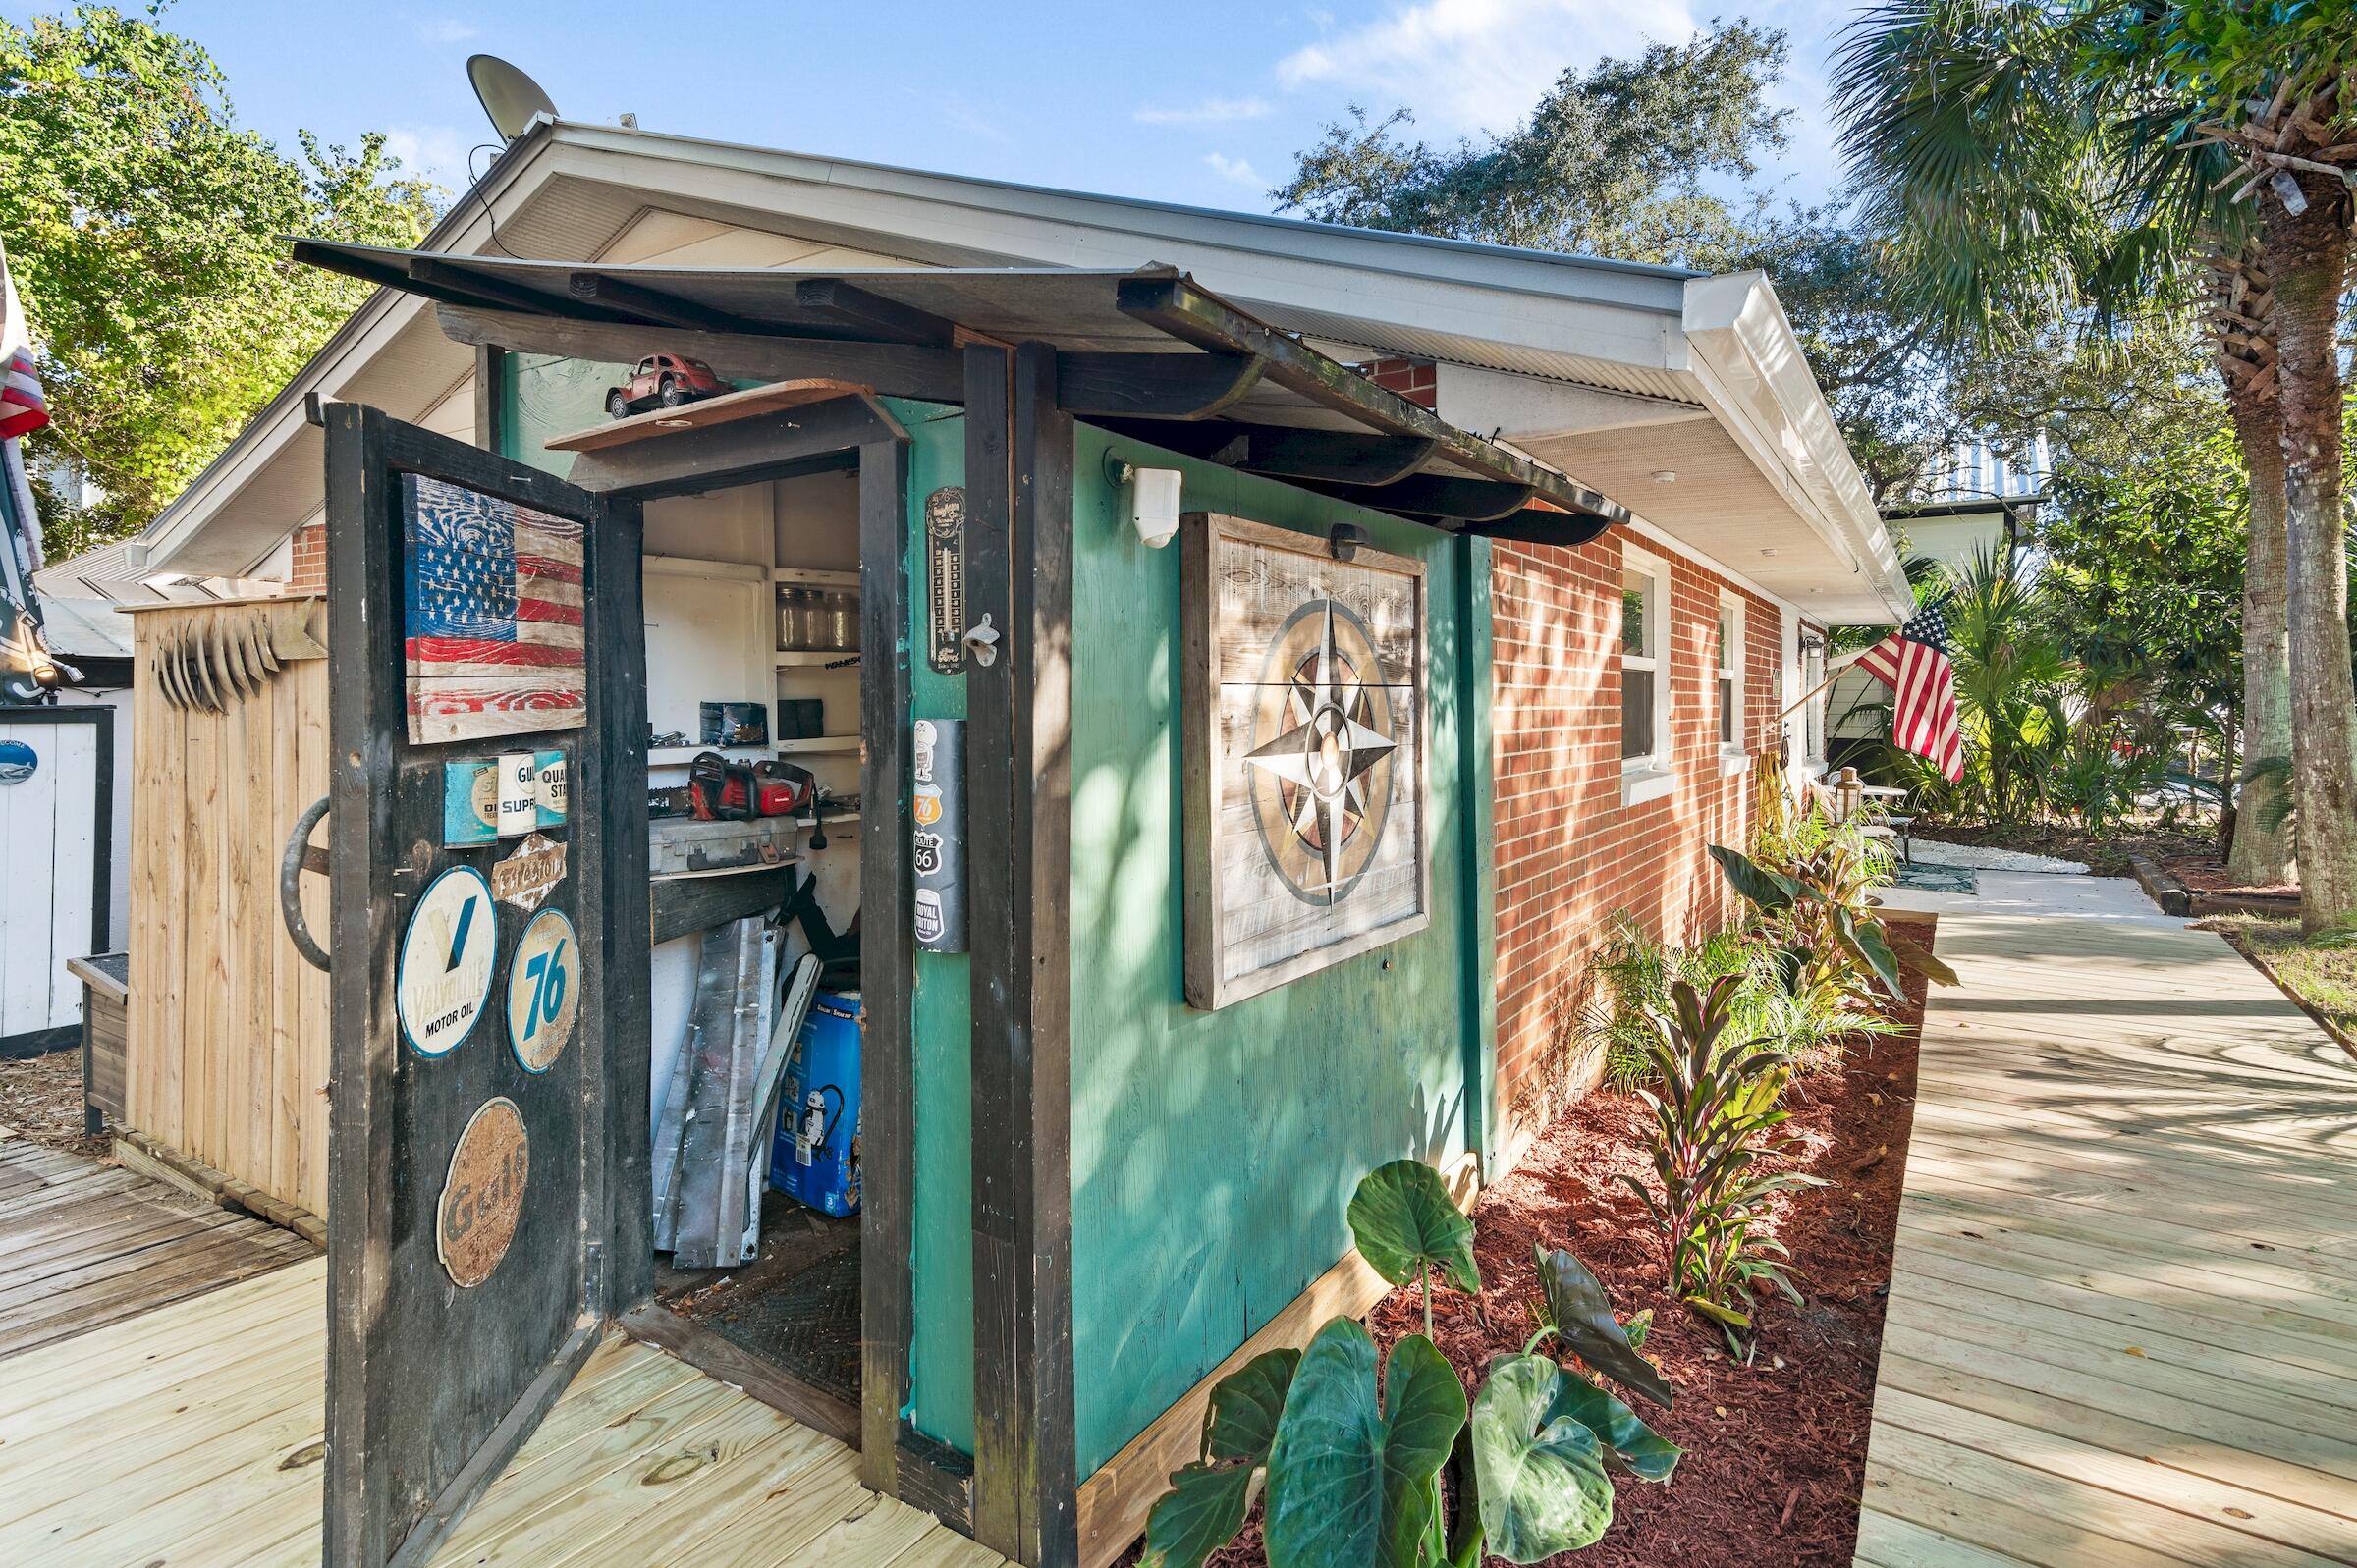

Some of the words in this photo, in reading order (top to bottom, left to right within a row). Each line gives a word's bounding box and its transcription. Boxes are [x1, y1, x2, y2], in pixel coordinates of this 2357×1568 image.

[915, 836, 934, 846] ROUTE
[915, 849, 933, 868] 66
[916, 903, 938, 919] ROYAL
[522, 937, 567, 1042] 76
[425, 1009, 459, 1039] MOTOR
[460, 1001, 474, 1019] OIL
